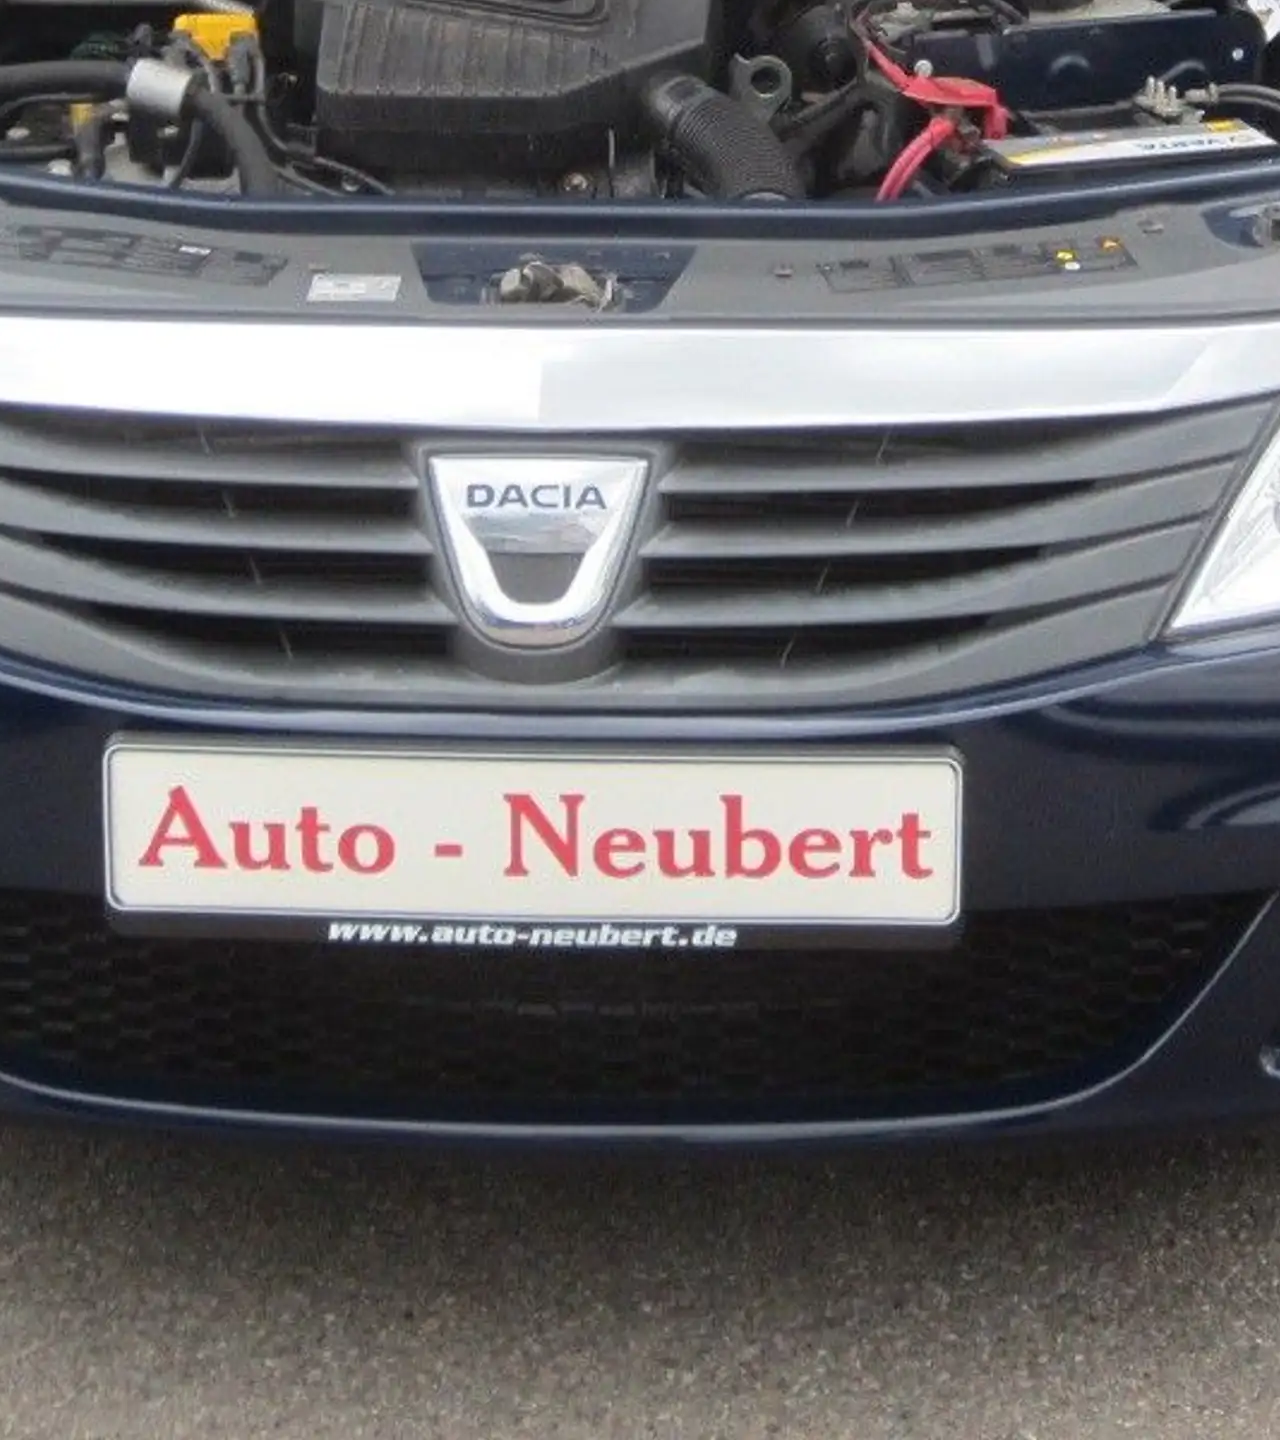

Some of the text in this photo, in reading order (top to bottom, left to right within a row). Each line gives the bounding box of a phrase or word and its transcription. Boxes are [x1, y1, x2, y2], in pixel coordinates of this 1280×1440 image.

[466, 484, 607, 509] DACIA
[139, 785, 933, 880] Auto - Neubert
[327, 921, 738, 948] www.auto-neubert.de
